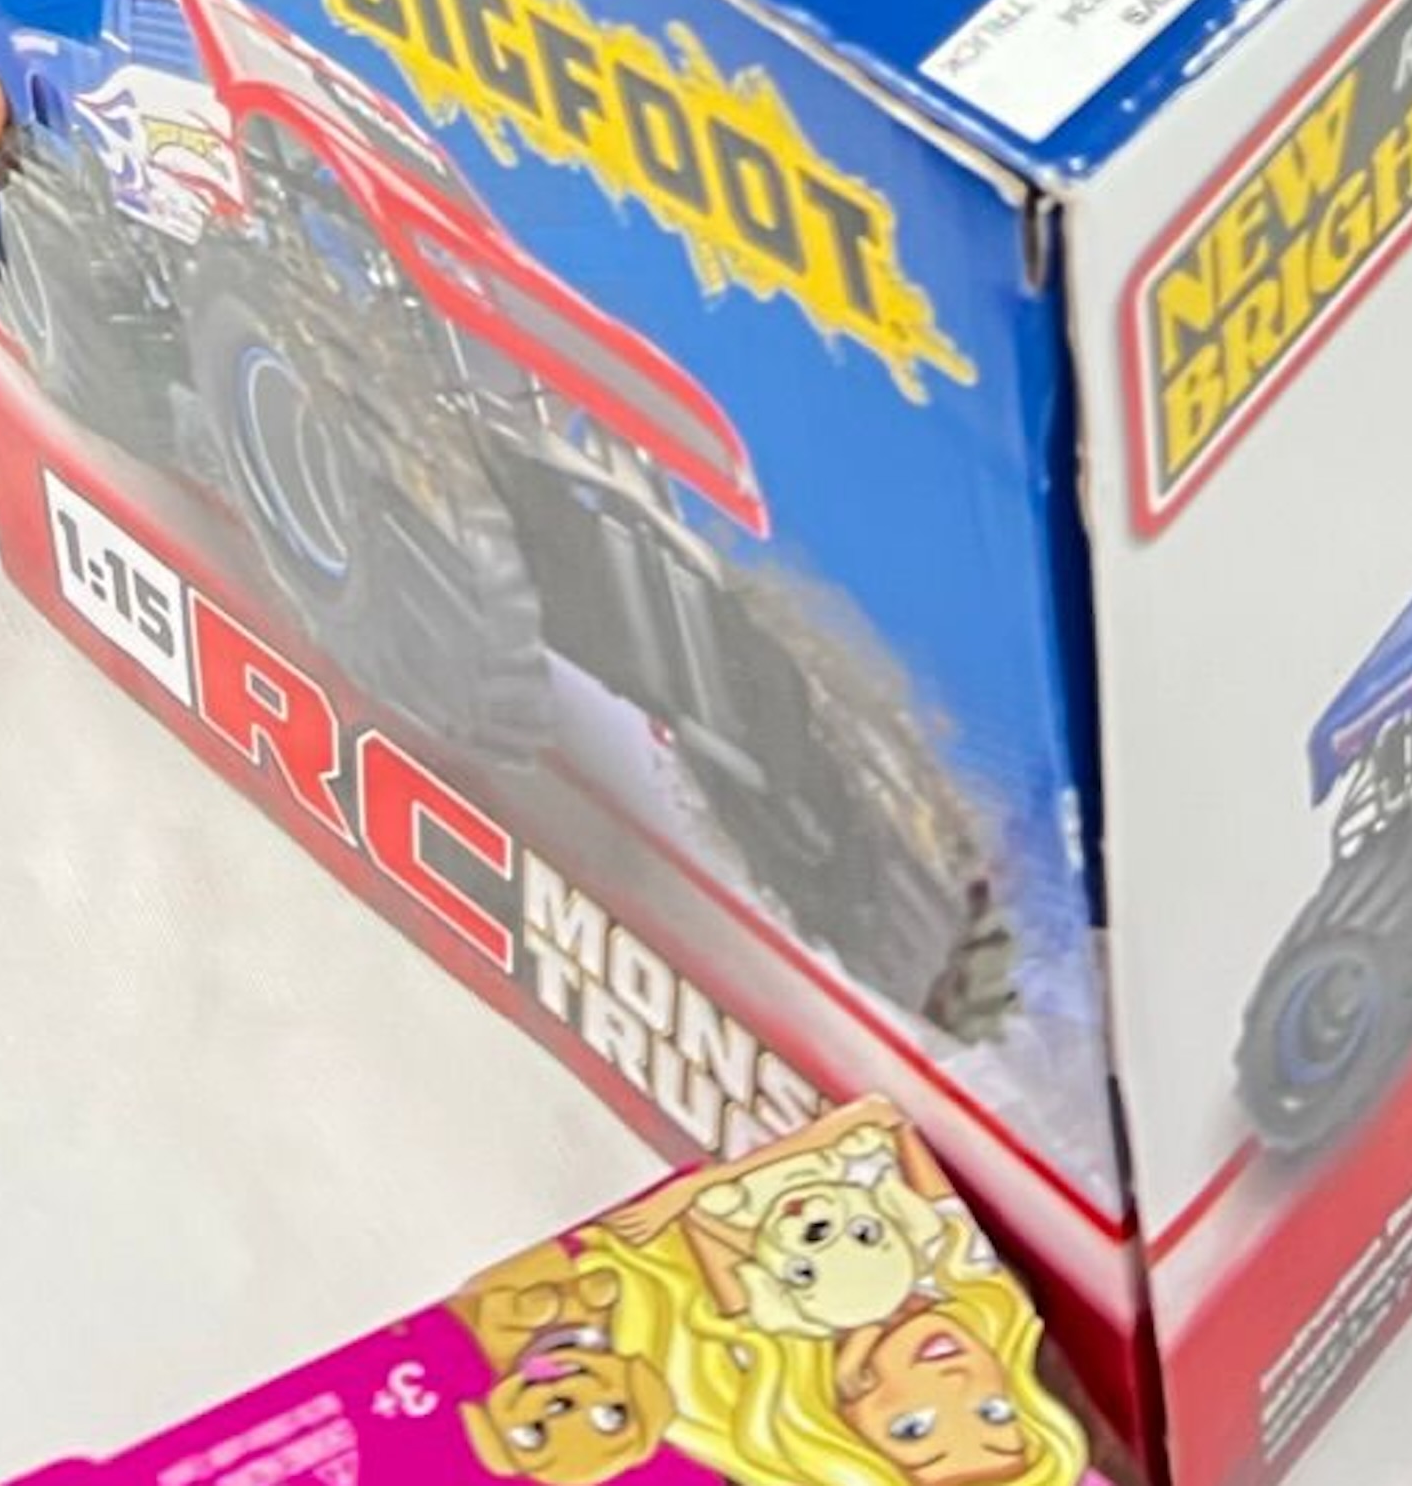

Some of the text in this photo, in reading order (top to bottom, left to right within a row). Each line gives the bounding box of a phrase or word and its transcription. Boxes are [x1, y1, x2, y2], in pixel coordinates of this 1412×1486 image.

[940, 0, 1035, 77] TRUCK
[1157, 67, 1359, 371] NEW
[57, 509, 514, 975] 1:15 RC
[371, 1361, 440, 1418] 3+
